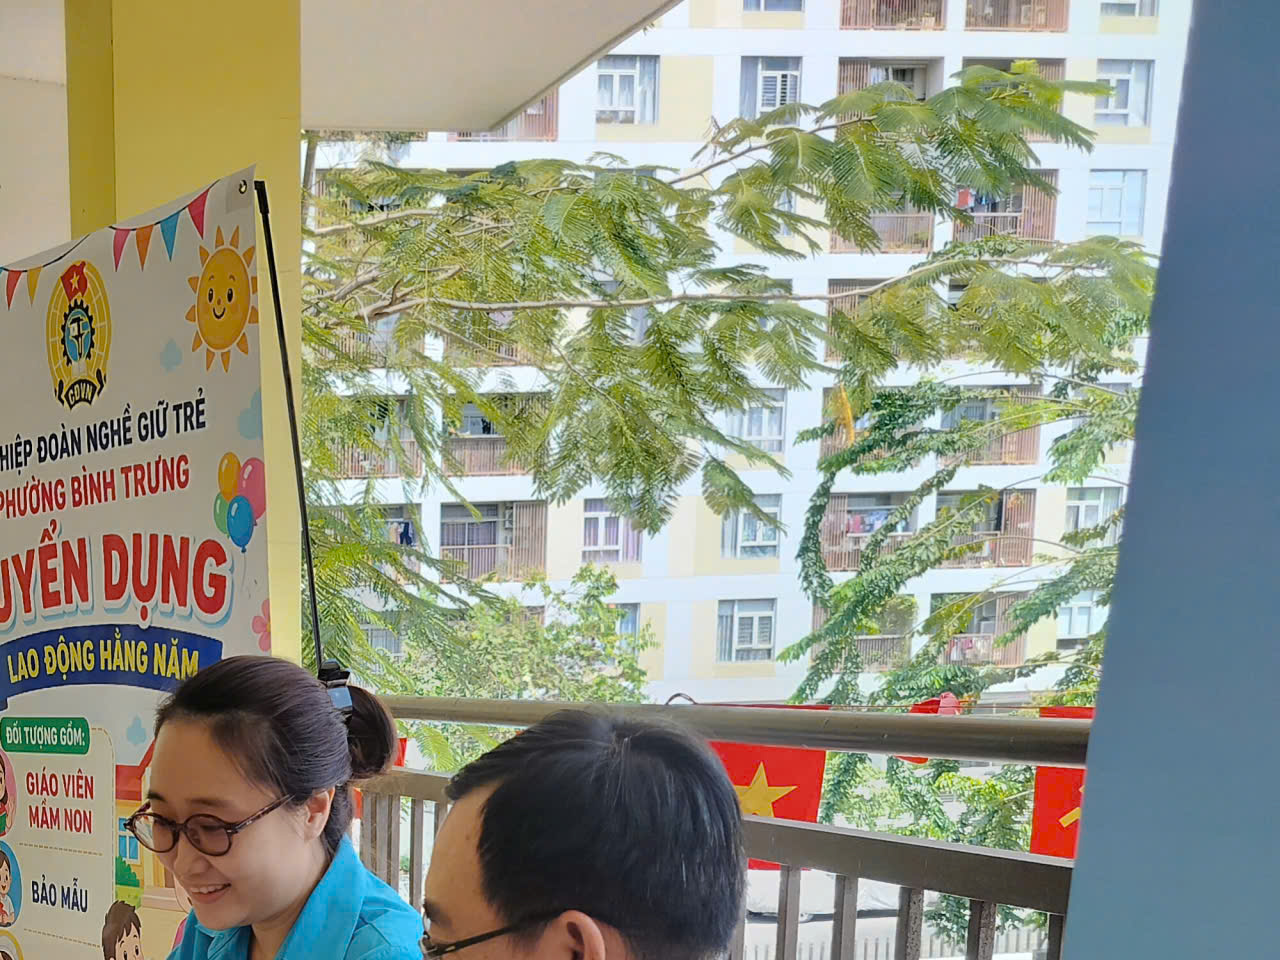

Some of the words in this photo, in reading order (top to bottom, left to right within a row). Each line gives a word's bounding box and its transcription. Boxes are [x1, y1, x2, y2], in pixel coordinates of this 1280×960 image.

[37, 423, 82, 463] ĐOÀN
[86, 403, 133, 453] NGHỀ
[137, 400, 169, 442] GIỮ
[173, 387, 207, 434] TRẺ
[70, 465, 117, 508] BÌNH
[121, 454, 190, 498] TRƯNG
[102, 532, 228, 622] DỤNG
[7, 648, 40, 684] LAO
[43, 634, 95, 681] ĐỘNG
[153, 637, 199, 680] NĂM
[5, 720, 22, 744] ĐỐI
[23, 724, 57, 750] TƯỢNG
[26, 766, 58, 797] GIÁO
[61, 768, 94, 800] VIÊN
[29, 798, 60, 831] MẦM
[64, 808, 92, 834] NON
[31, 874, 57, 907] BẢO
[61, 877, 88, 913] MẪU
